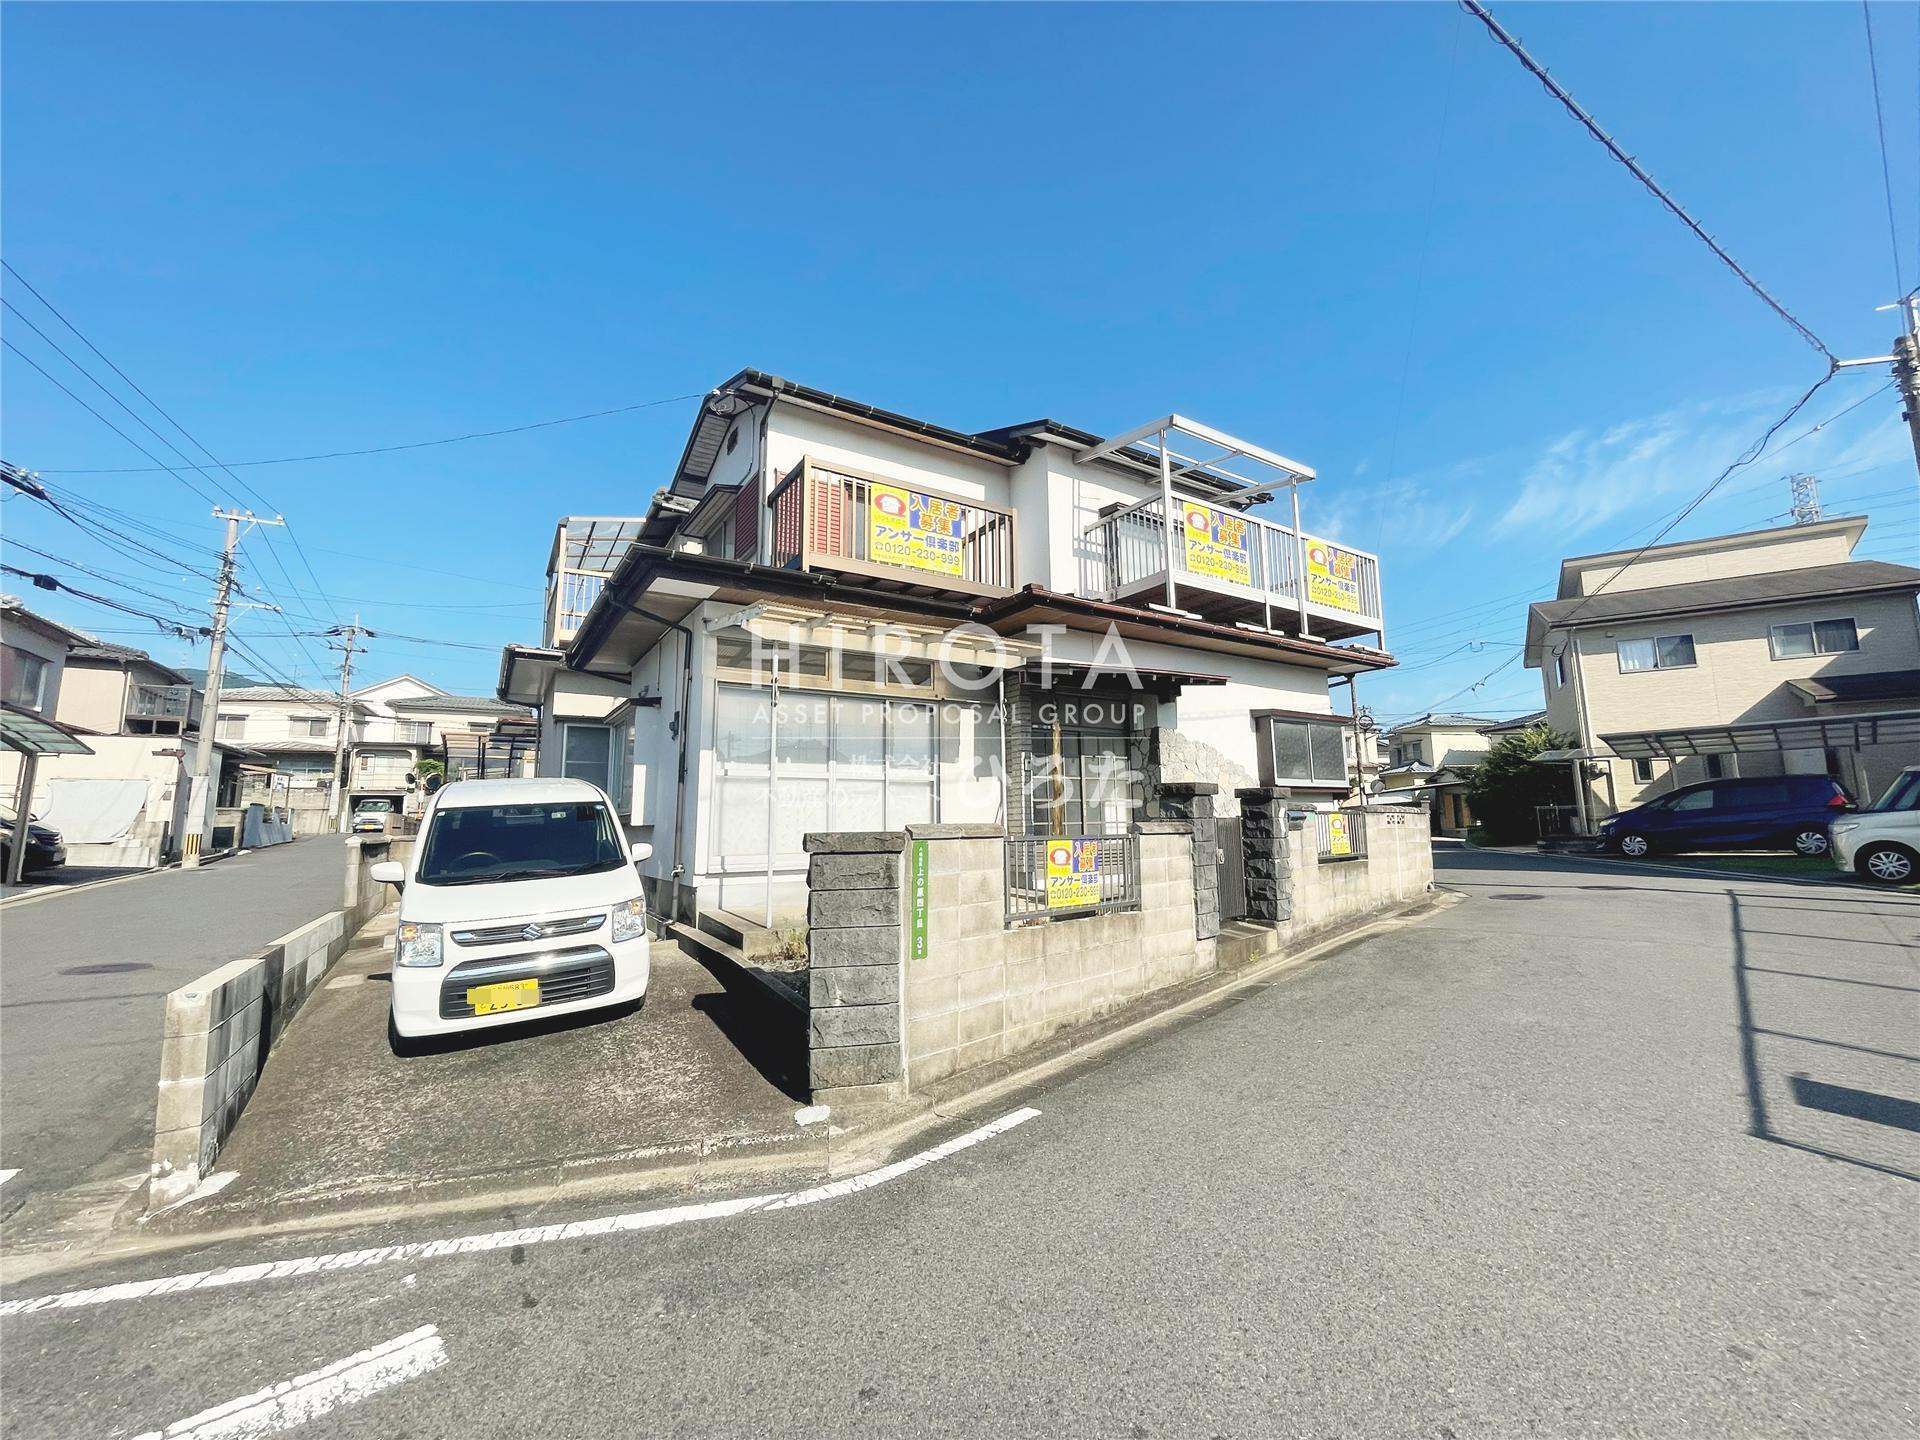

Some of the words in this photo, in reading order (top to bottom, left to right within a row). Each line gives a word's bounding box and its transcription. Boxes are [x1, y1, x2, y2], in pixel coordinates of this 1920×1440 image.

[910, 495, 960, 520] 入居者
[920, 513, 951, 534] 募集
[1211, 512, 1245, 534] 入居者
[875, 525, 960, 553] アンサー倶楽部
[884, 542, 960, 566] 0120-230-999
